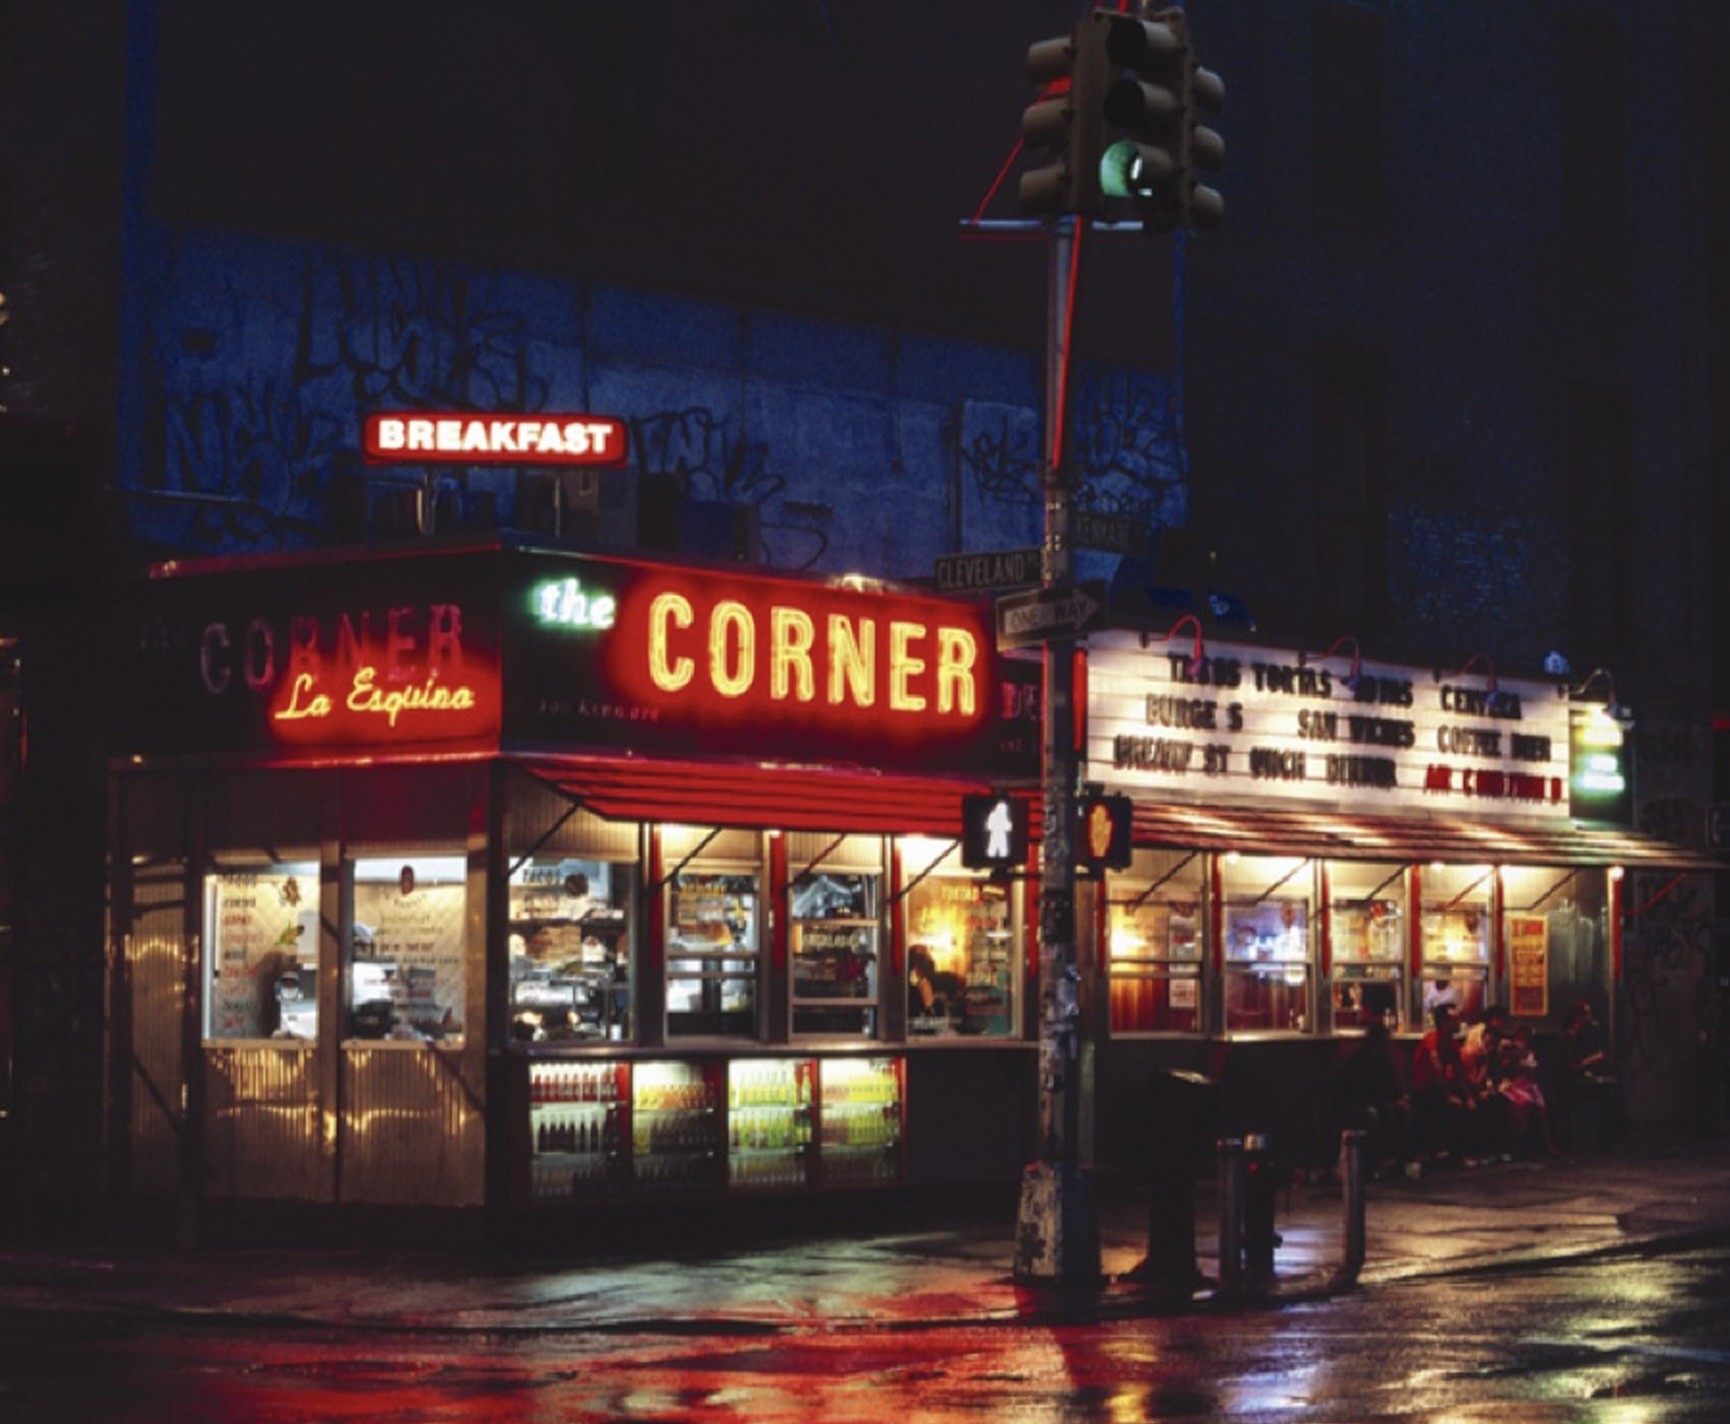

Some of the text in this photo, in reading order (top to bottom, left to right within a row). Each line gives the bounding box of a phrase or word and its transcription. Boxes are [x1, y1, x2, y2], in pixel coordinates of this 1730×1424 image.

[379, 419, 612, 455] BREAKFAST
[937, 554, 1025, 589] CLEVELAND
[1011, 606, 1040, 631] ONE
[200, 603, 464, 694] CORNER
[538, 578, 977, 716] the CORNER
[274, 666, 475, 727] La Esquina
[1440, 685, 1522, 719] CERVZA
